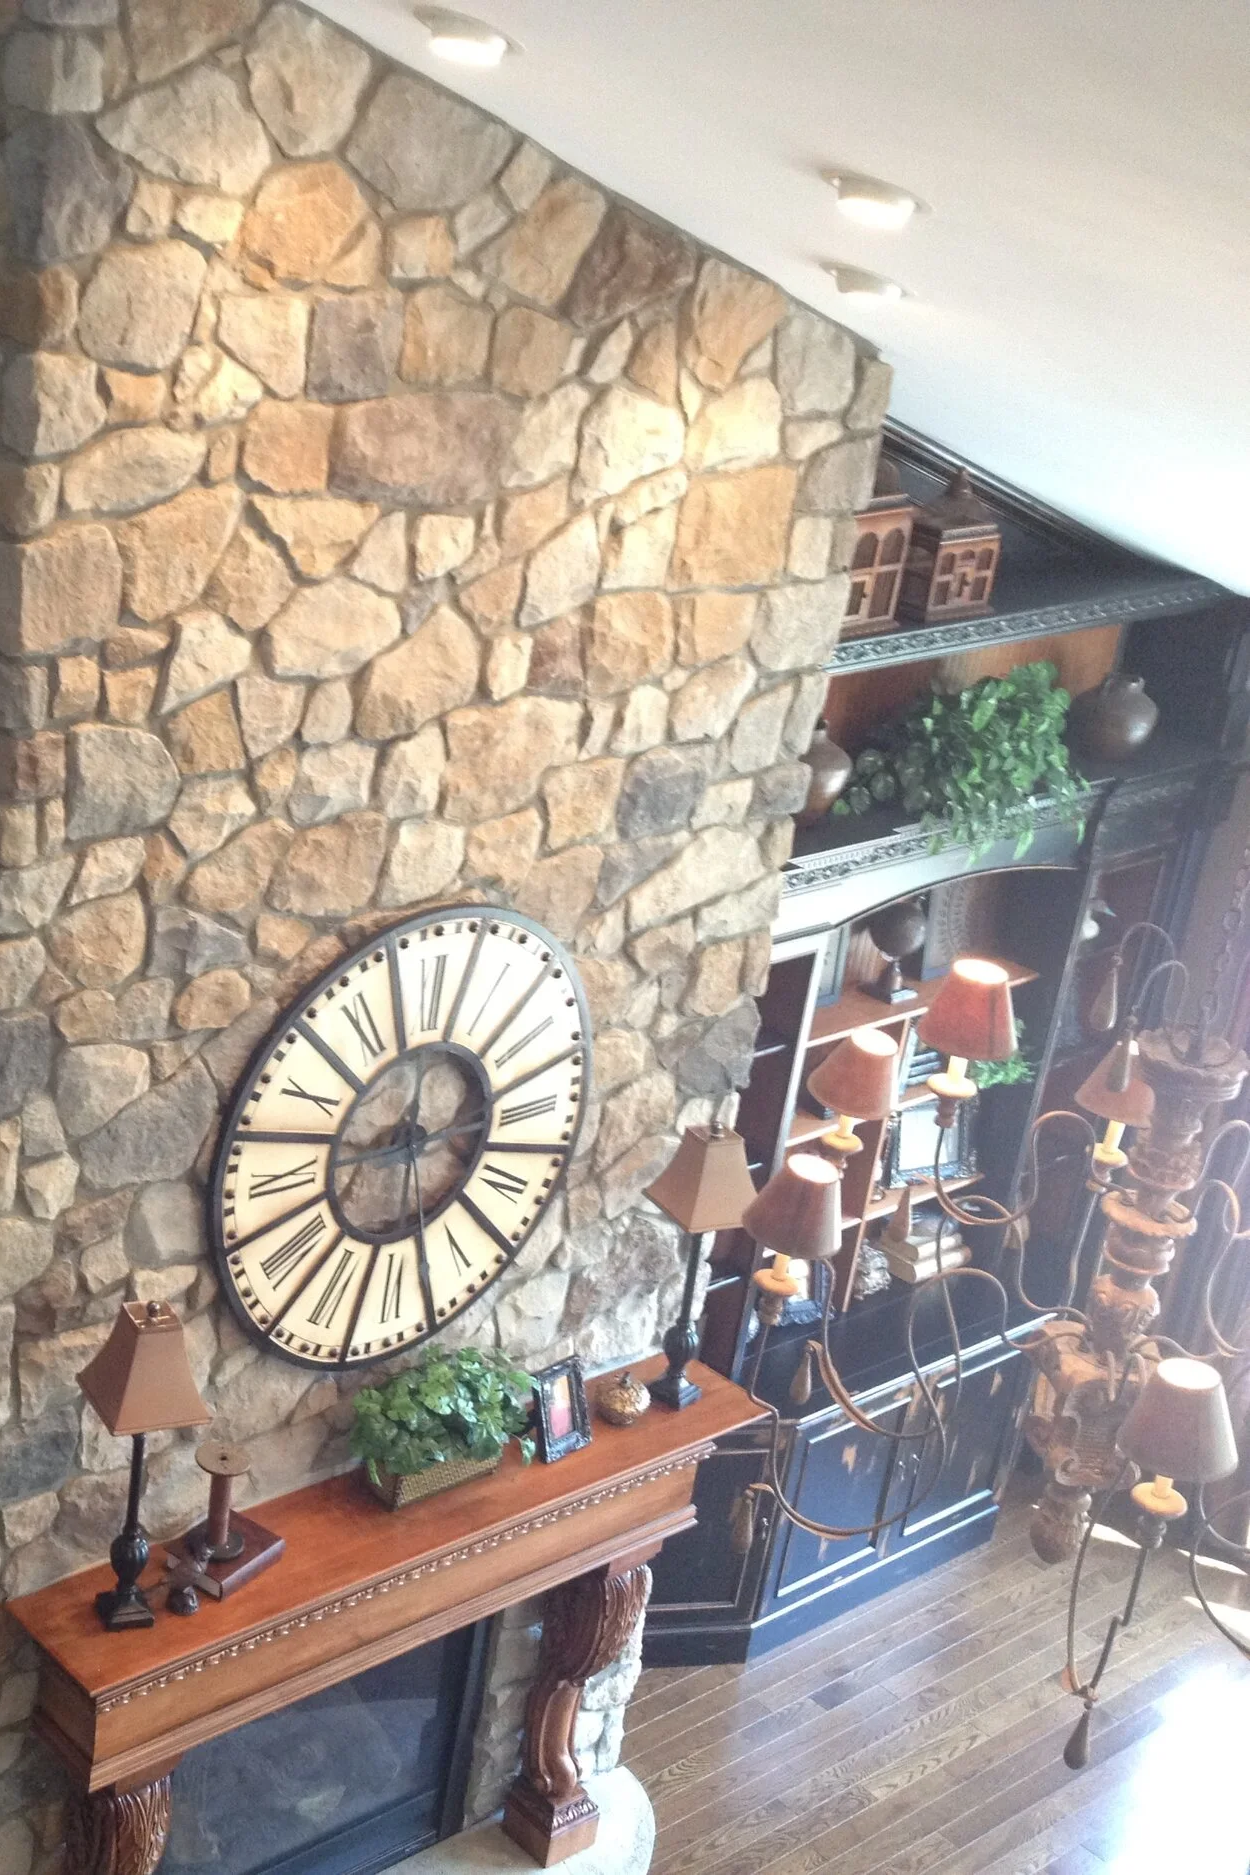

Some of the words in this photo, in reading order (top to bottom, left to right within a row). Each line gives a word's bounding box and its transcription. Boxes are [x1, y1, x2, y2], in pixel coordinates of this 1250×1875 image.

[409, 953, 449, 1036] XII
[467, 962, 511, 1036] I
[339, 990, 386, 1067] XI
[494, 1015, 554, 1070] II
[279, 1075, 342, 1118] X
[498, 1093, 558, 1131] III
[248, 1155, 318, 1201] IX
[478, 1162, 529, 1205] IV
[259, 1211, 328, 1292] VIII
[443, 1219, 472, 1277] V
[305, 1247, 362, 1330] VII
[378, 1252, 404, 1324] VI
